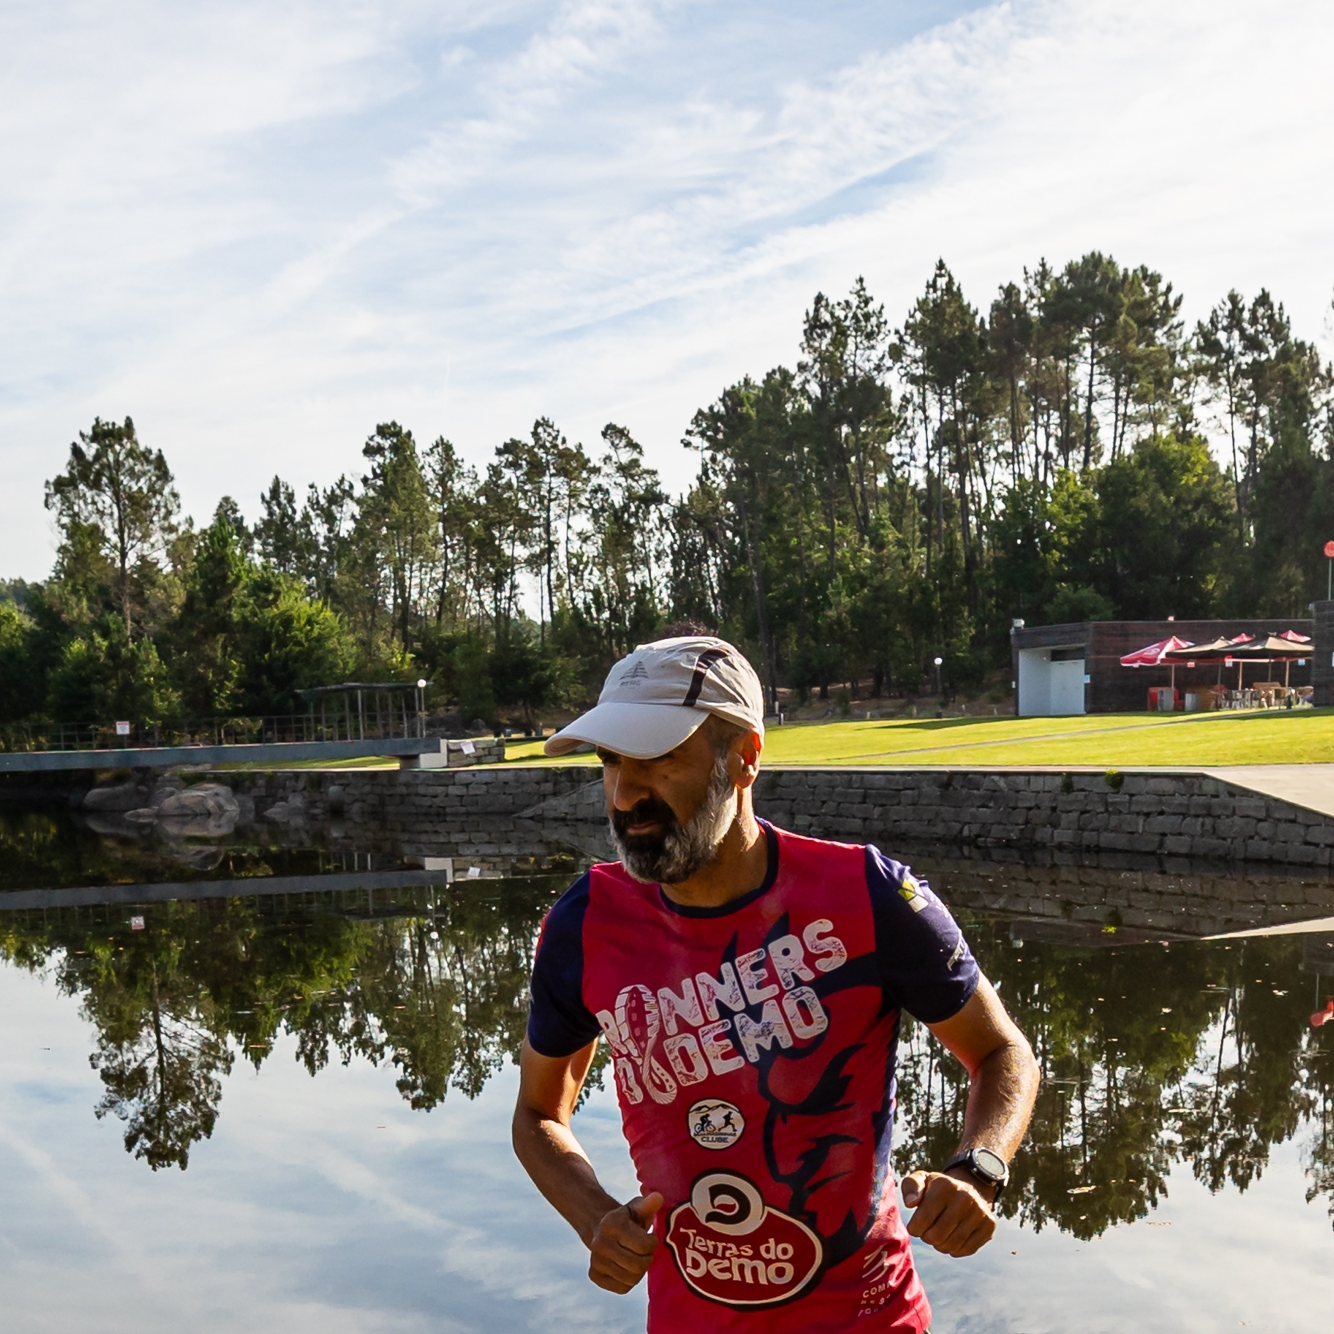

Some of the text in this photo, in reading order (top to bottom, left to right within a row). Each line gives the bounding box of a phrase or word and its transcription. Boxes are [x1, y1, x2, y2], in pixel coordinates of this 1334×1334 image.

[663, 986, 829, 1087] DEMO
[679, 1227, 794, 1260] Terras do
[685, 1247, 795, 1285] Demo
